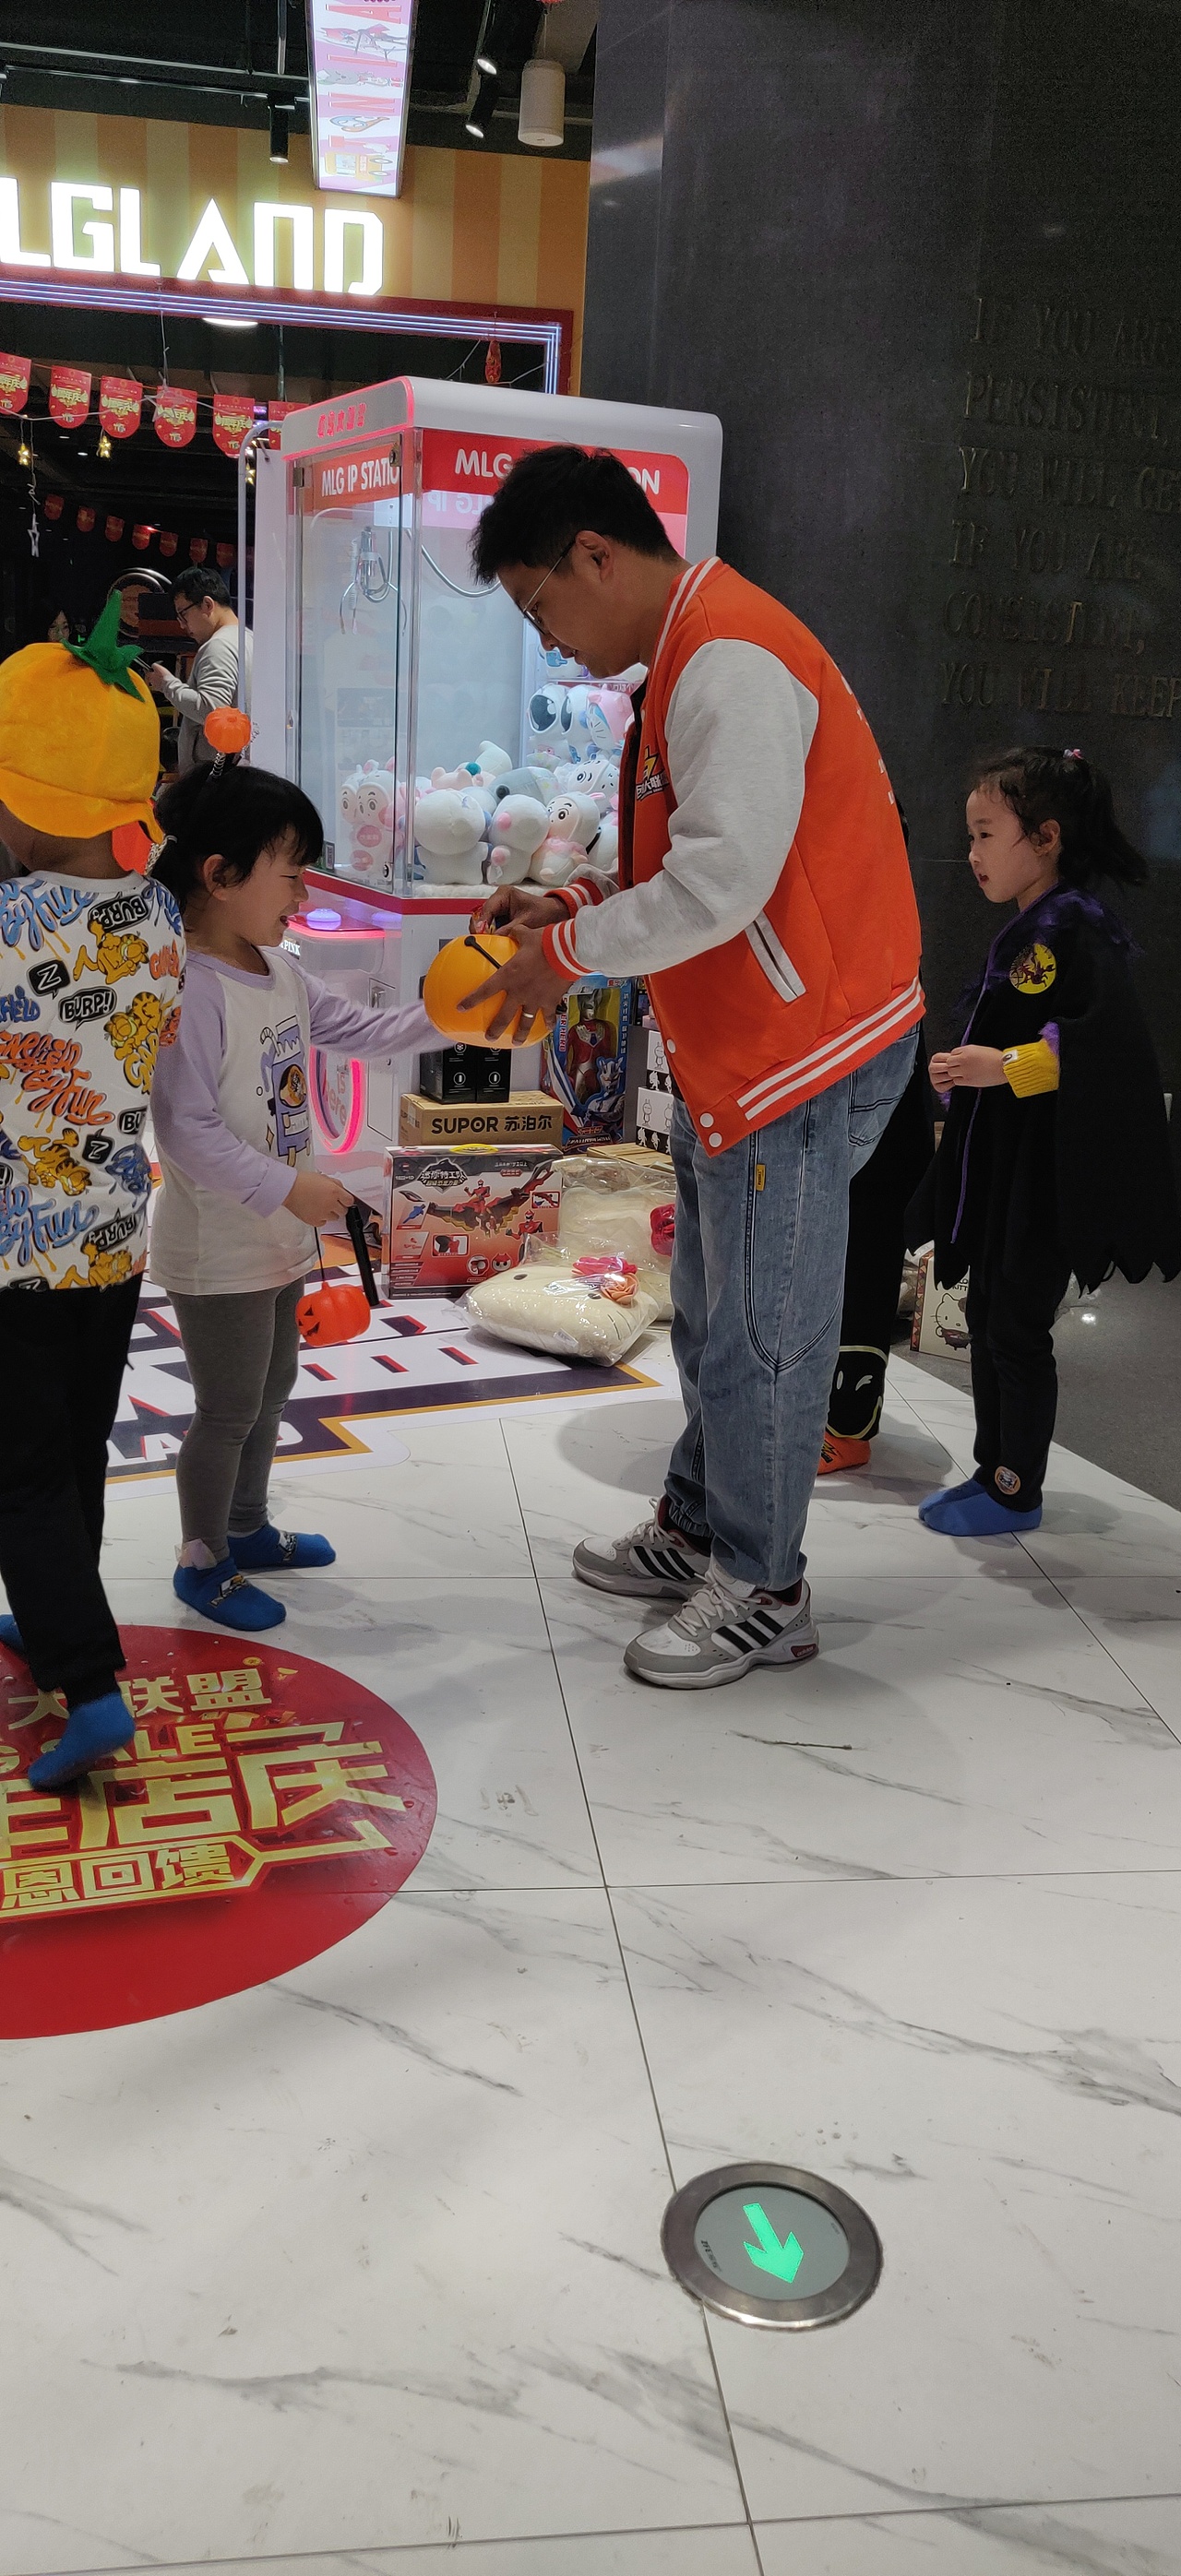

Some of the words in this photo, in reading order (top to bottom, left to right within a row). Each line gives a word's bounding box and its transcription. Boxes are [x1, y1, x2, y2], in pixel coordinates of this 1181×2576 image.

[322, 465, 344, 496] MLG
[348, 461, 358, 493] IP
[361, 457, 400, 490] STATIO
[455, 447, 513, 479] MLG
[941, 661, 995, 708] YOU
[62, 991, 111, 1023] BURP!
[431, 1117, 499, 1134] SUPOR
[505, 1115, 553, 1132] 苏泊尔
[2, 1845, 234, 1908] 恩回馈
